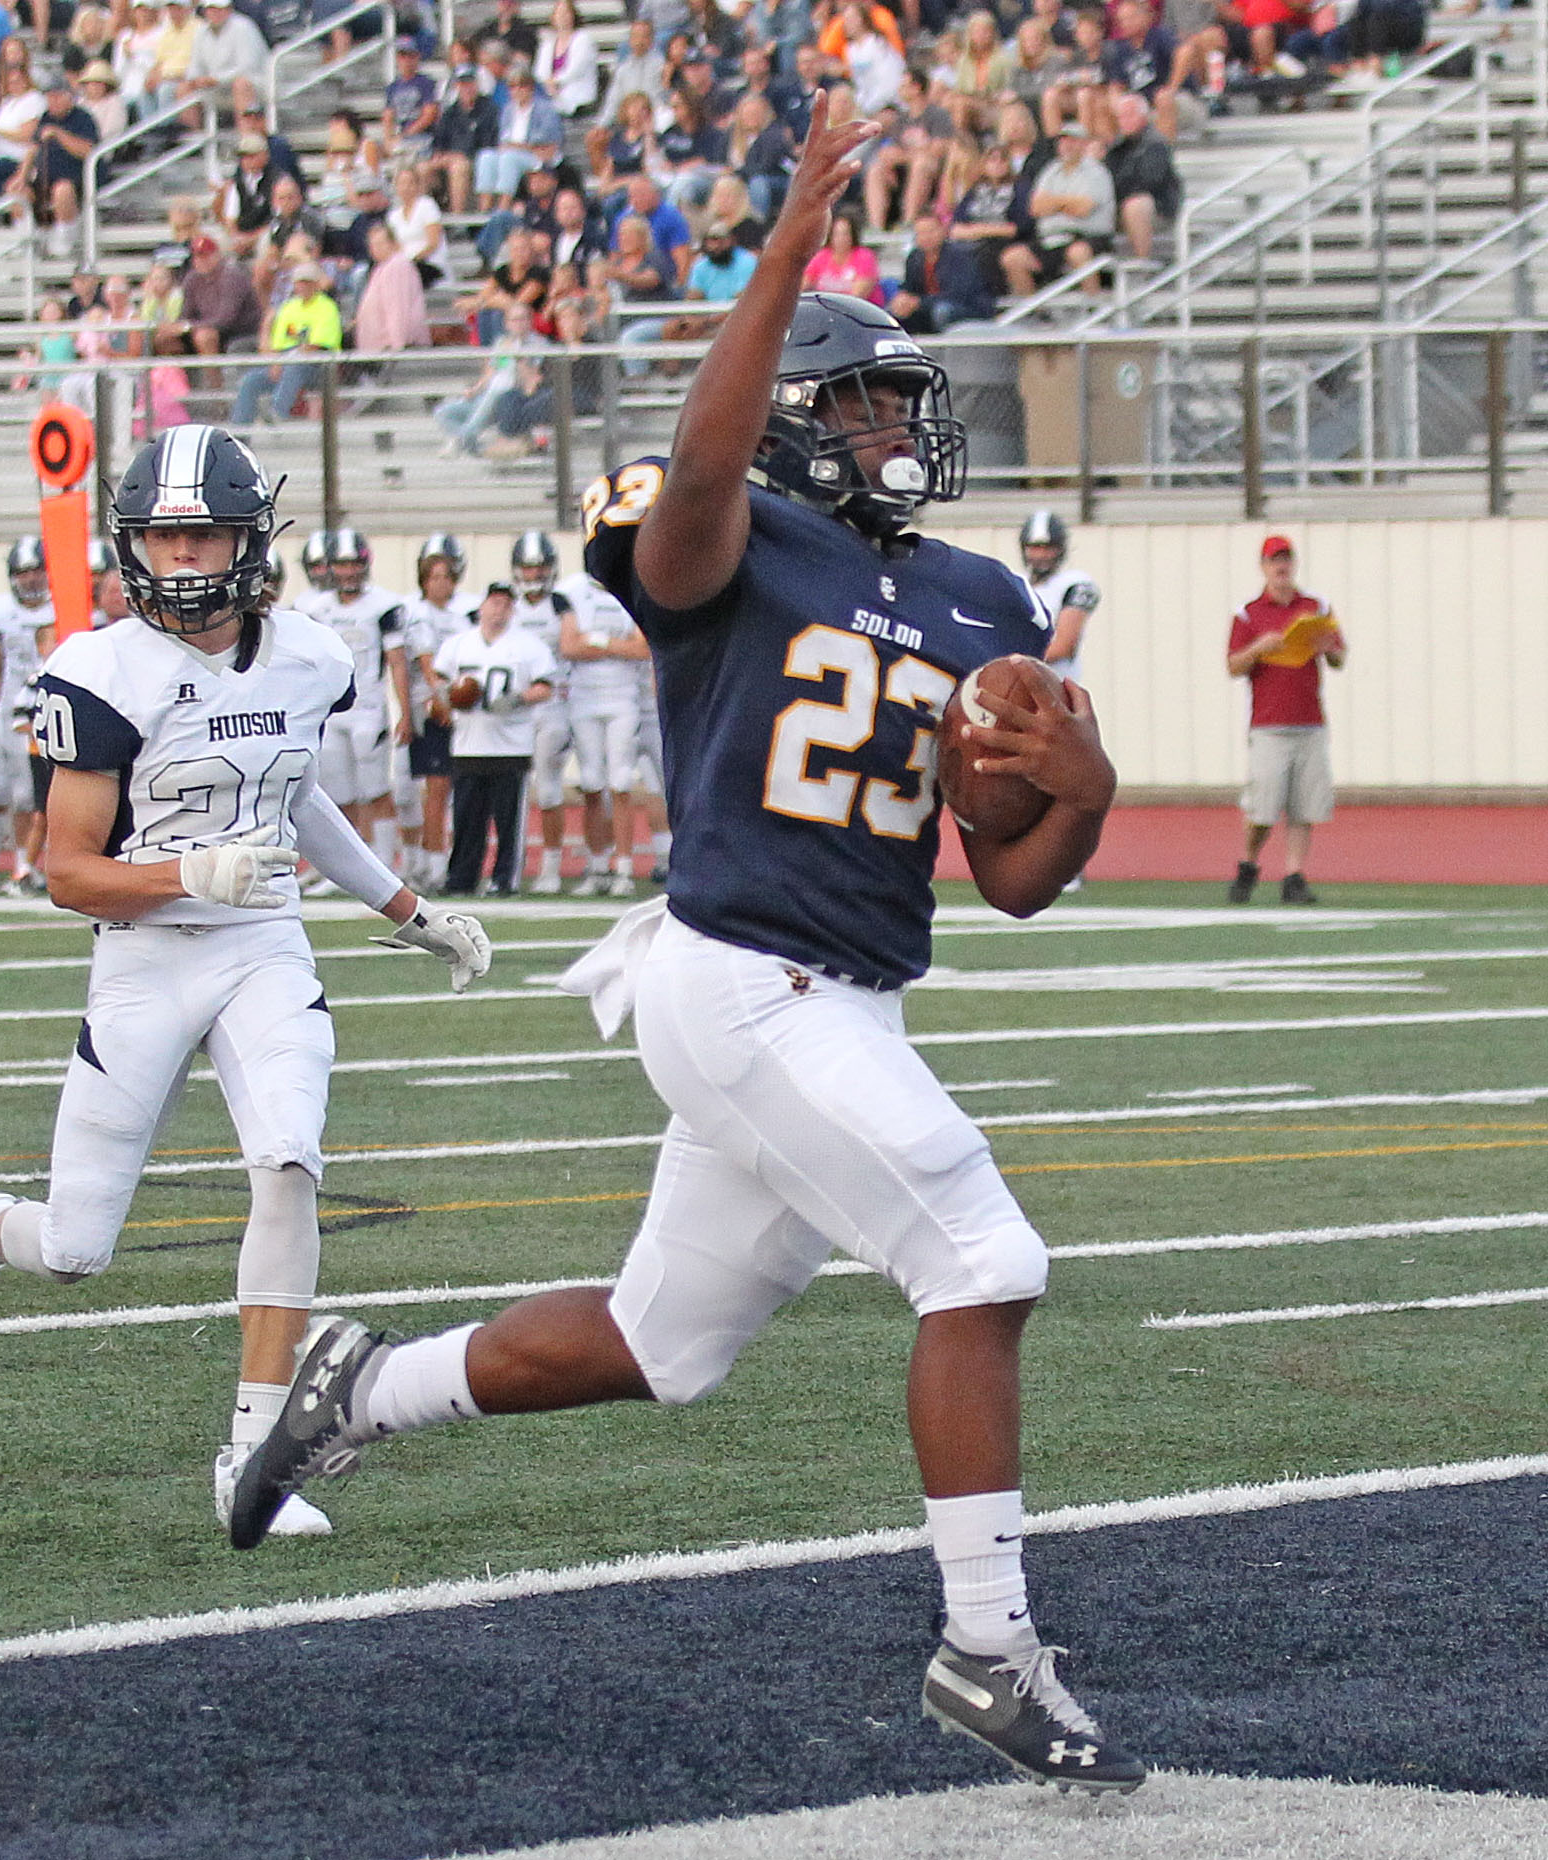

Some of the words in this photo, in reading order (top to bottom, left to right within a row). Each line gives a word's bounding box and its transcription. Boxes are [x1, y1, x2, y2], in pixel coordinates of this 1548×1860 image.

[158, 503, 203, 514] Riddell
[582, 463, 666, 543] 23
[851, 607, 925, 651] SOLON
[32, 686, 78, 763] 20
[208, 709, 288, 743] HUDSON
[762, 622, 959, 842] 23
